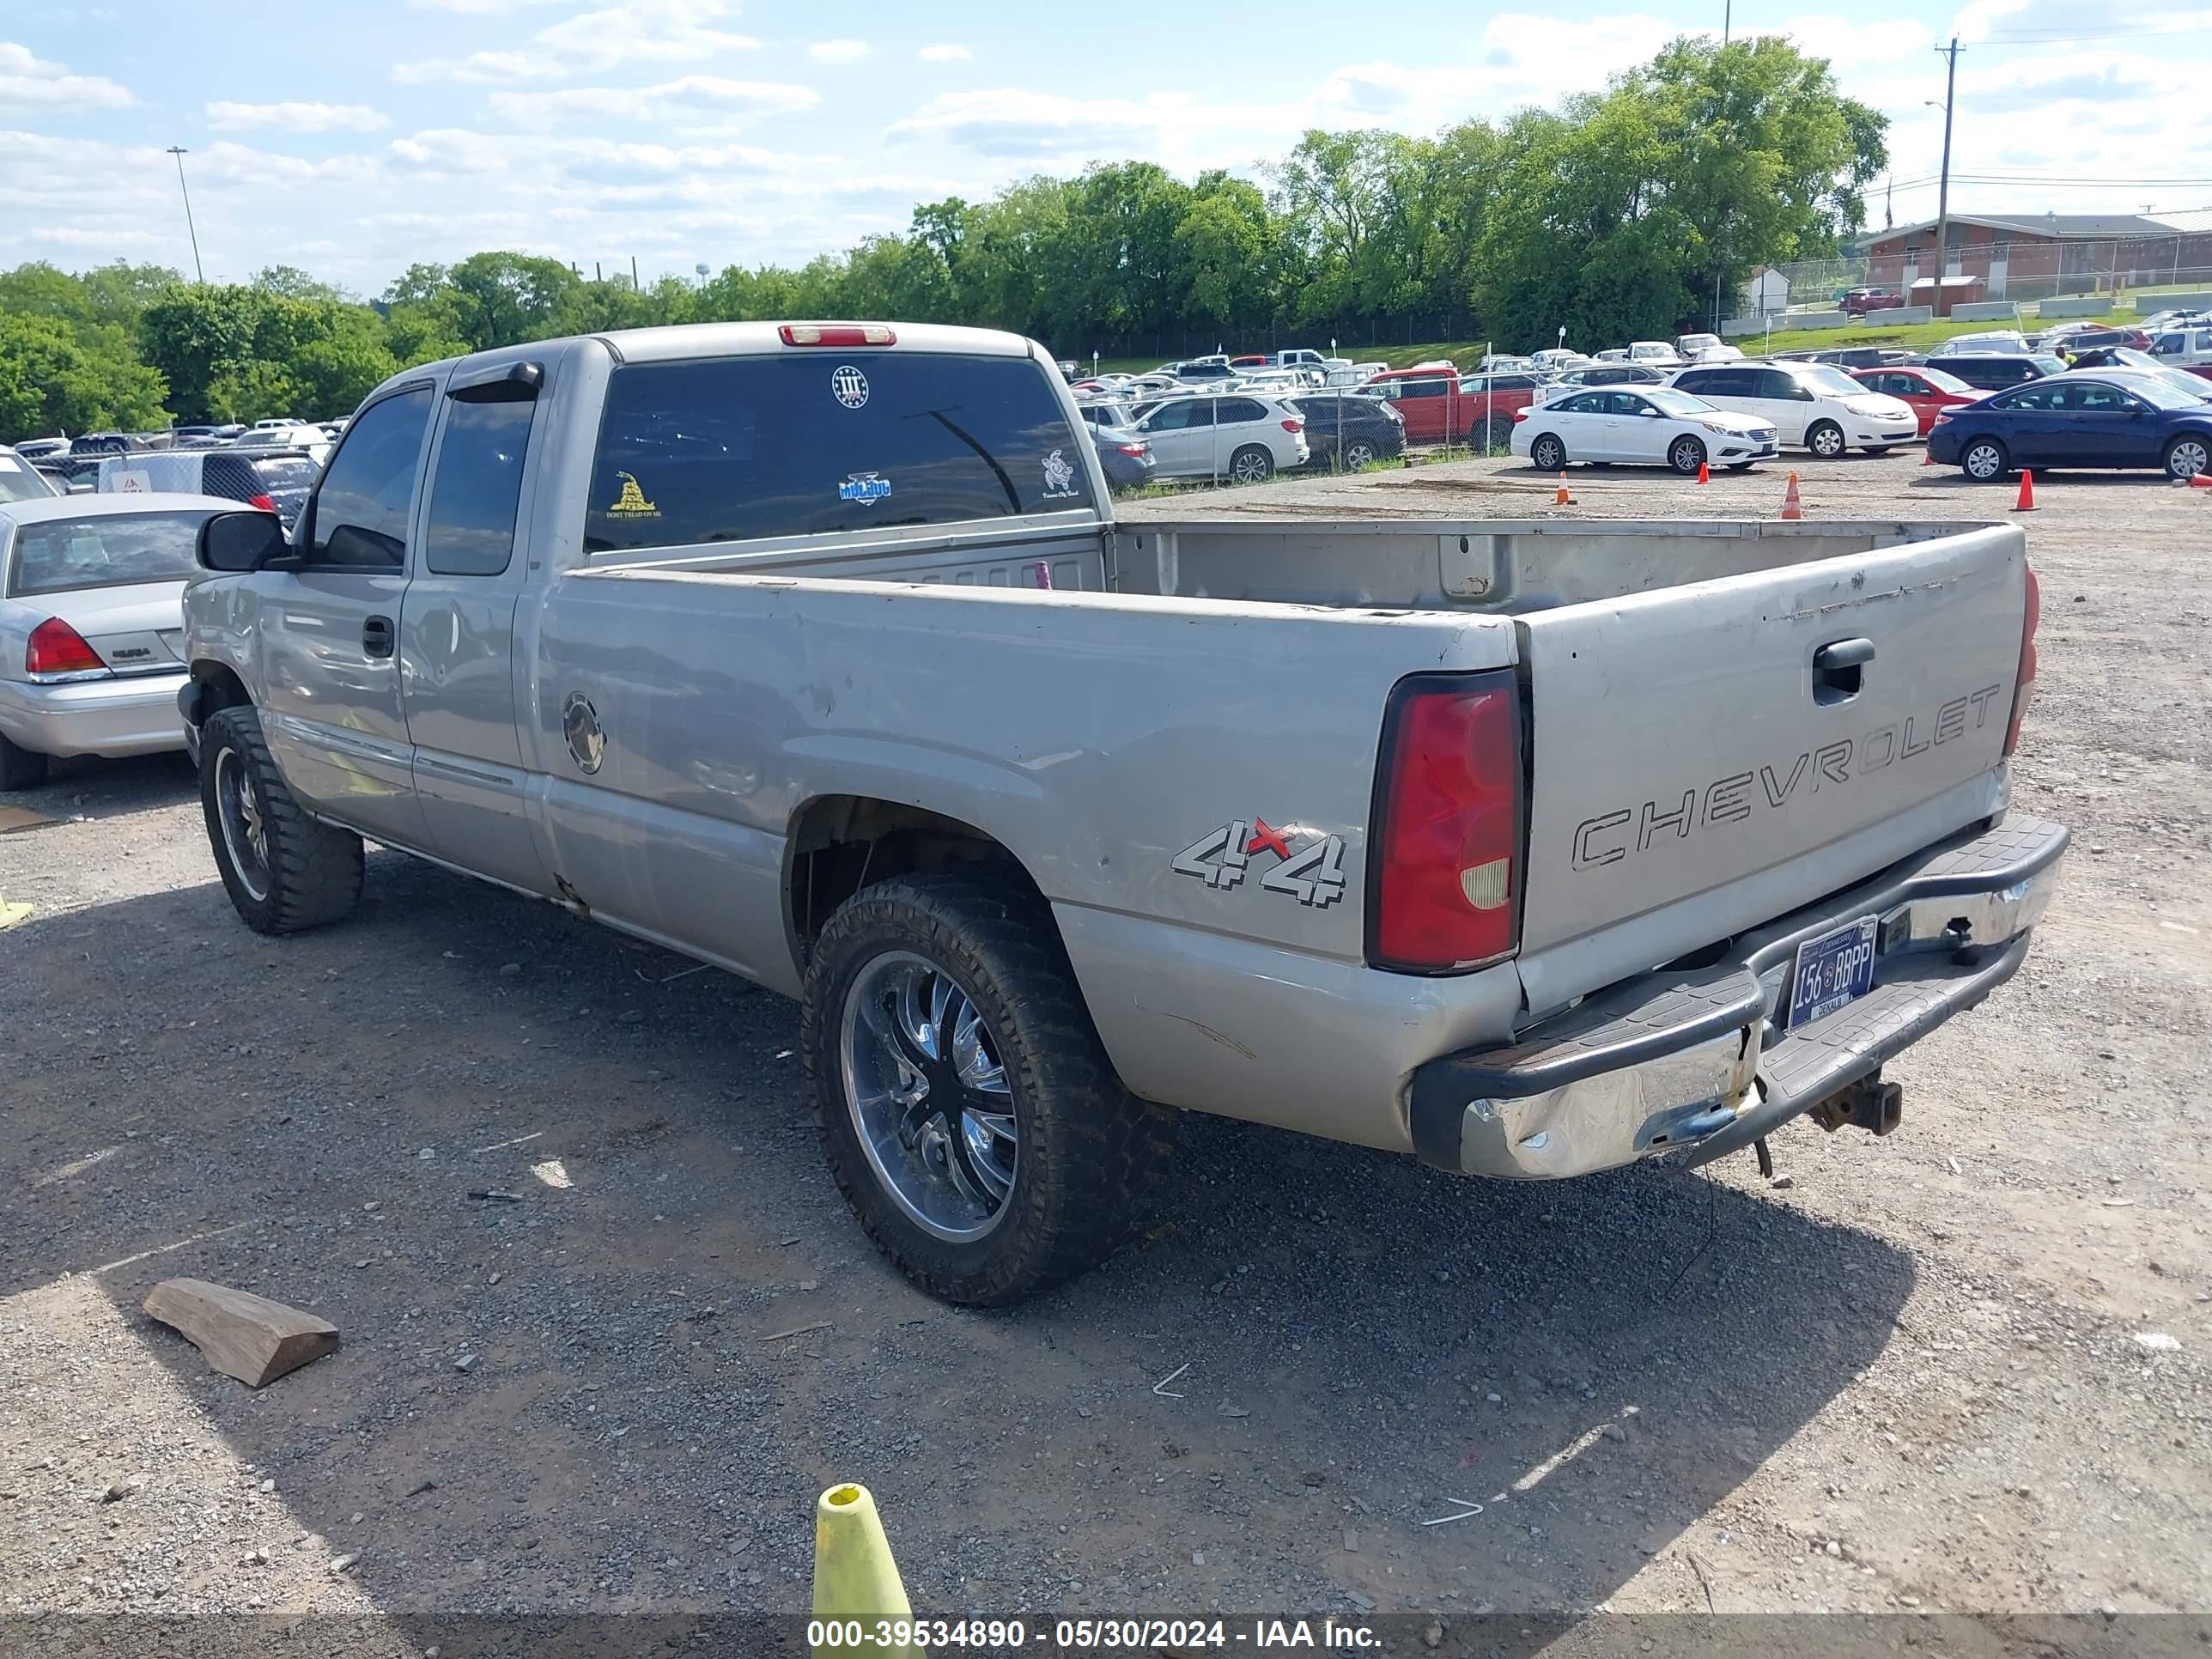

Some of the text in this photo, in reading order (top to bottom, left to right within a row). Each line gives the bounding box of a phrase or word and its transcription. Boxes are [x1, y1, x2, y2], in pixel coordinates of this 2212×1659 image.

[1571, 684, 2000, 873] CHEVROLET
[1795, 942, 1870, 1010] 156 BBPP
[1818, 996, 1842, 1016] DEKALB
